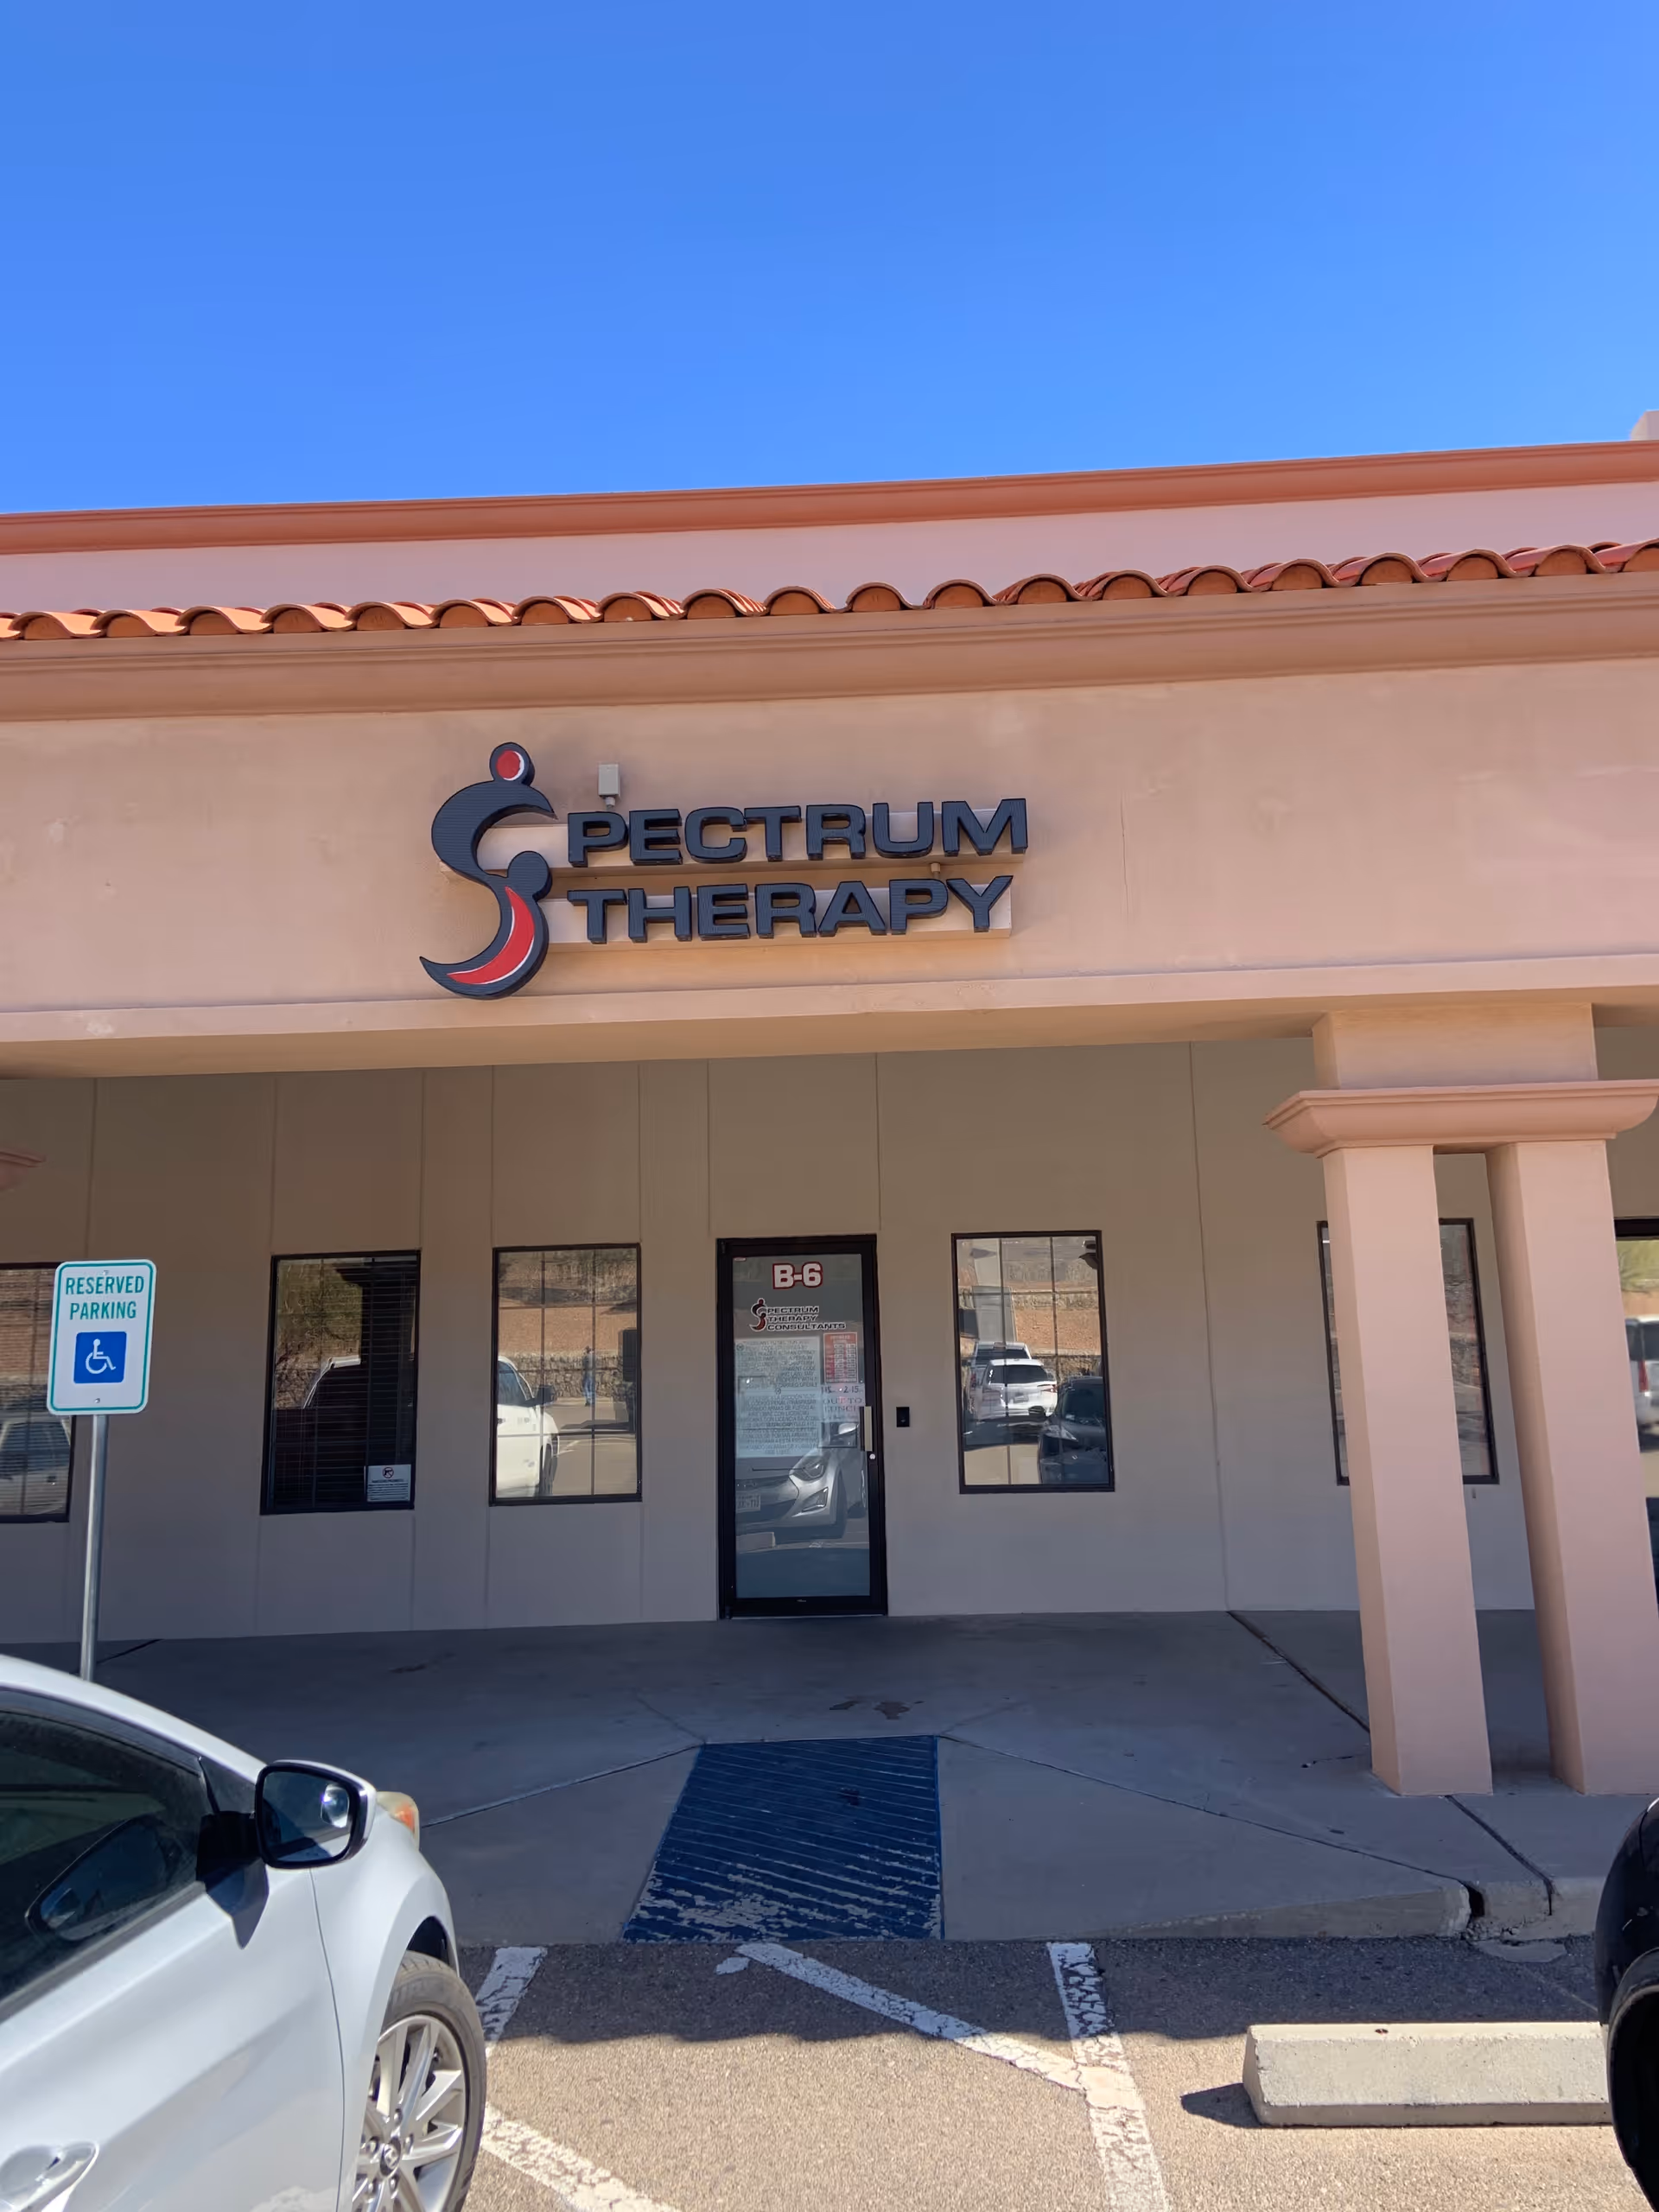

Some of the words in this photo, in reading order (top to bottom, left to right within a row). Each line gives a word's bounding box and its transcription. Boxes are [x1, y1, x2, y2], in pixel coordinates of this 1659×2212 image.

[567, 875, 1013, 944] THERAPY
[66, 1275, 144, 1294] RESERVED
[772, 1262, 823, 1289] B-6
[69, 1300, 137, 1320] PARKING
[767, 1314, 818, 1323] THERAPY
[766, 1322, 846, 1331] CONSULTANTS
